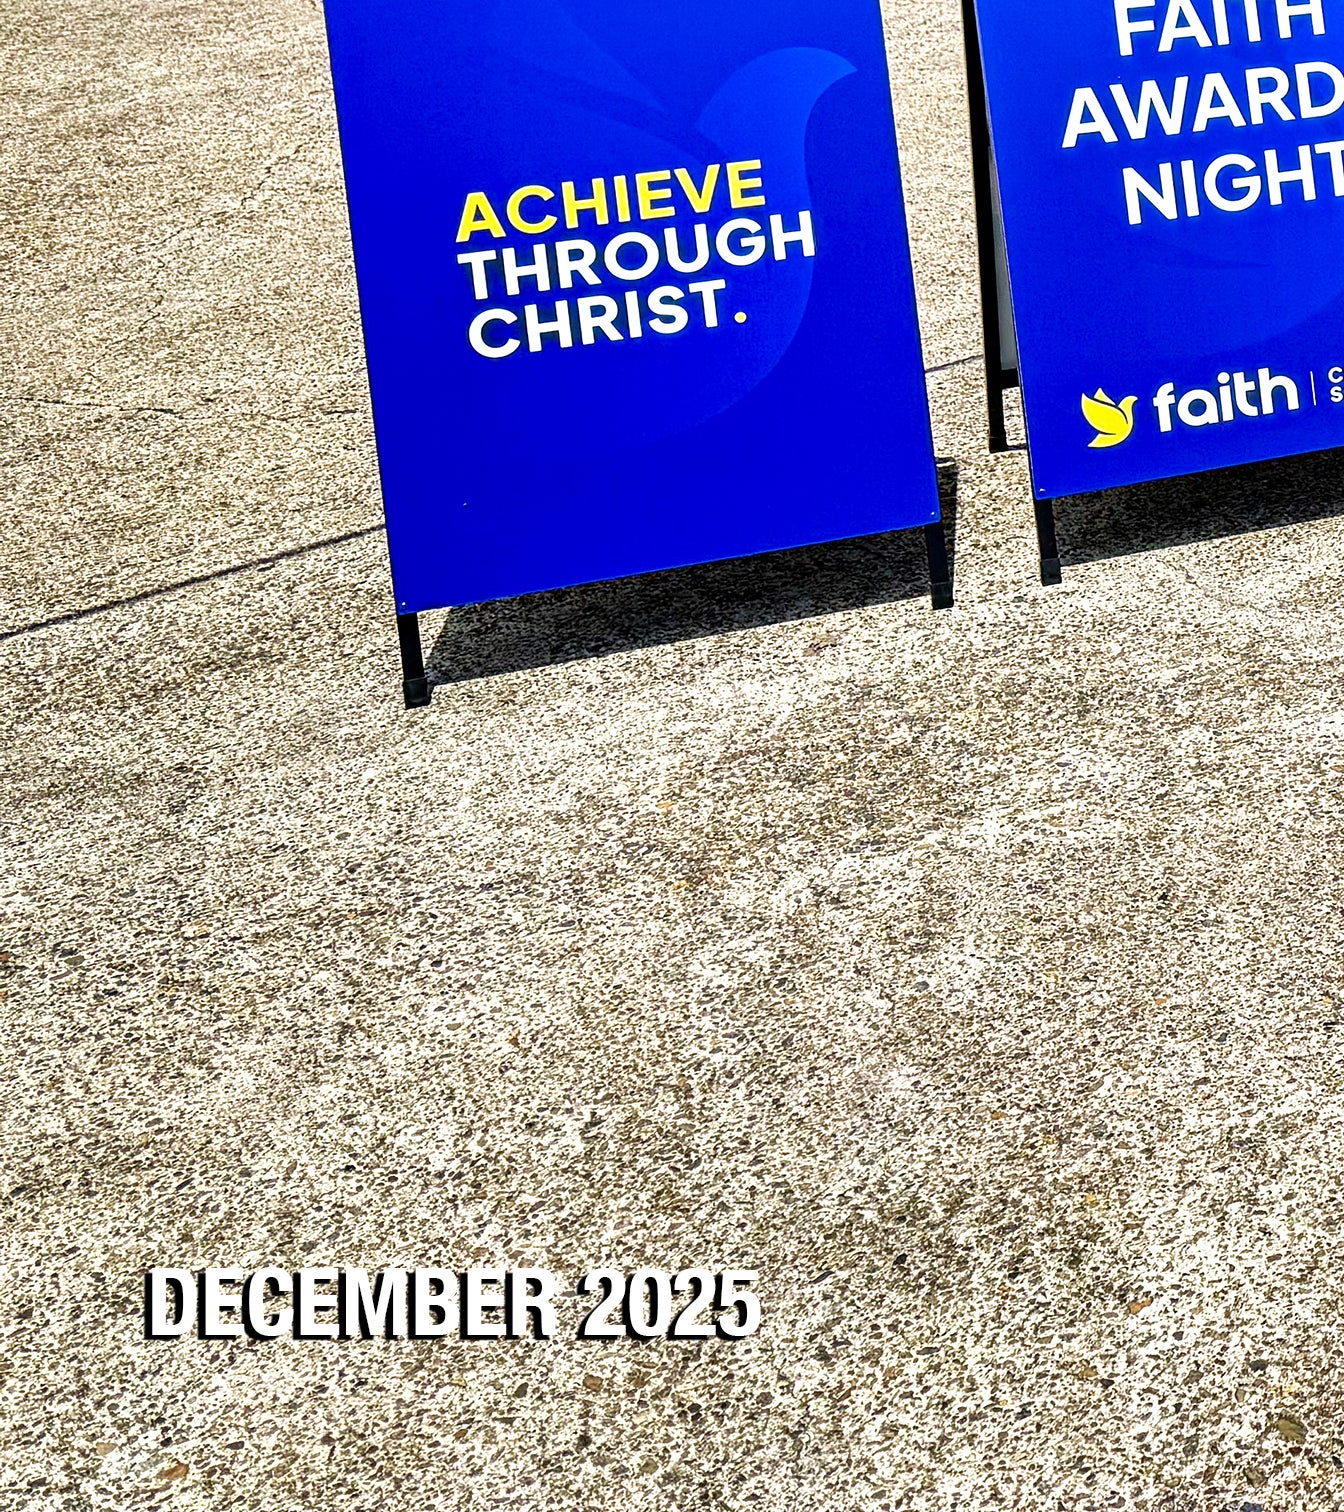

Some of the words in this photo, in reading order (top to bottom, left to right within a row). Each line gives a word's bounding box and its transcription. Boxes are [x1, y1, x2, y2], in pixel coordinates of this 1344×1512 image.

[455, 159, 766, 243] ACHIEVE
[457, 210, 816, 301] THROUGH
[467, 279, 748, 359] CHRIST.
[1153, 367, 1300, 433] faith
